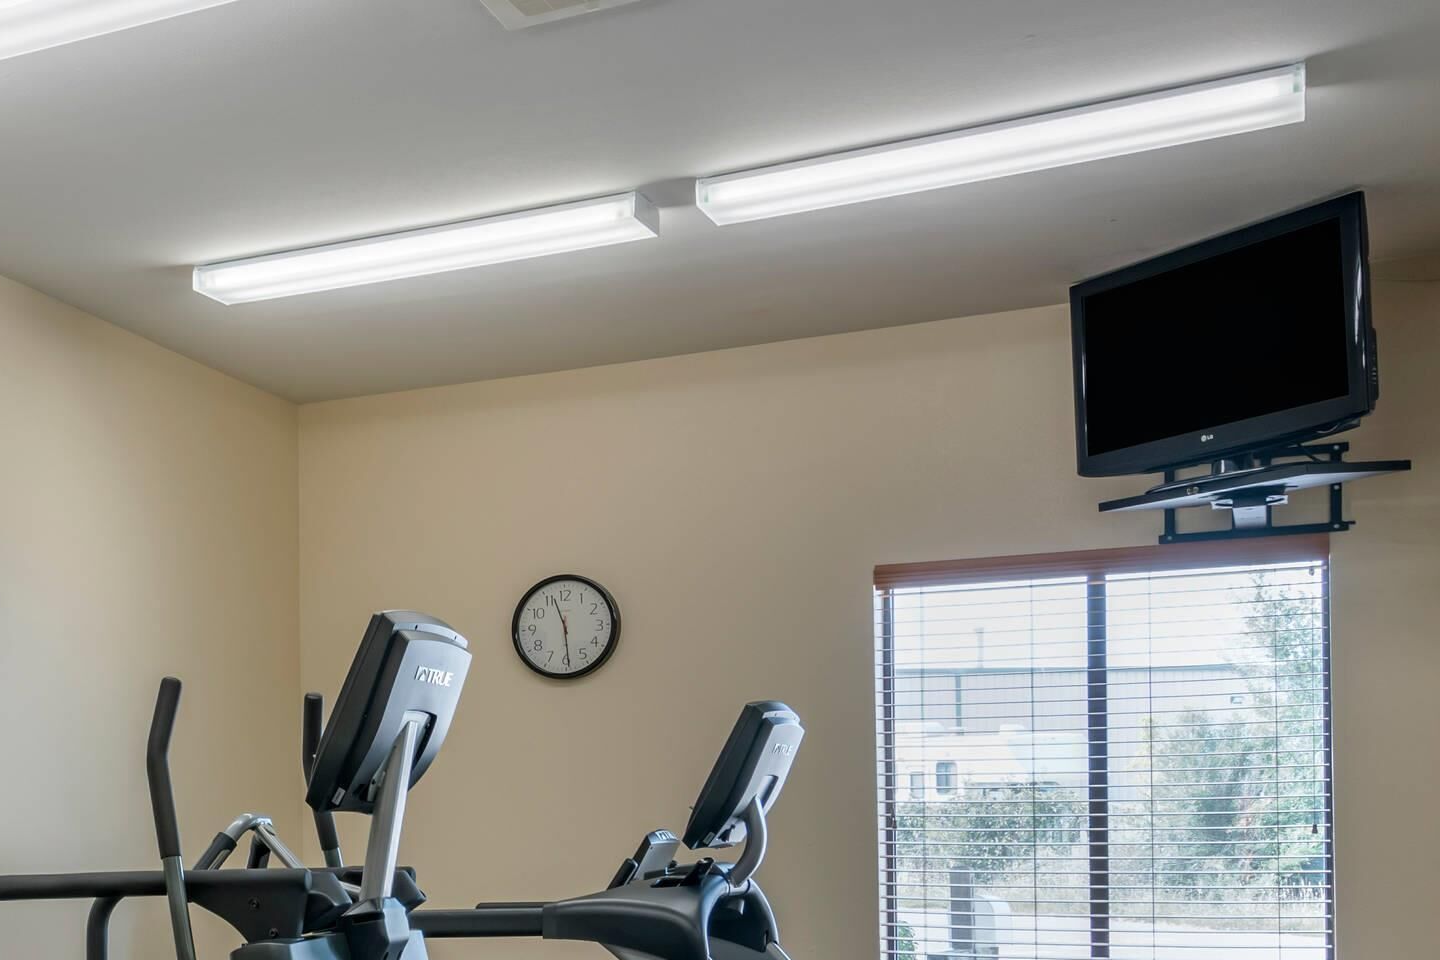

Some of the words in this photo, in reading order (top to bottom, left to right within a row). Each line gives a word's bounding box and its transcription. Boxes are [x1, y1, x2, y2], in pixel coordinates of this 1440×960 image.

[545, 594, 554, 607] 11
[559, 589, 572, 602] 12
[580, 592, 584, 605] 1
[532, 607, 545, 620] 10
[589, 602, 598, 615] 2
[527, 624, 537, 636] 9
[595, 619, 604, 632] 3
[533, 639, 543, 652] 8
[590, 636, 599, 648] 4
[546, 650, 554, 663] 7
[562, 653, 570, 666] 6
[578, 647, 588, 660] 5
